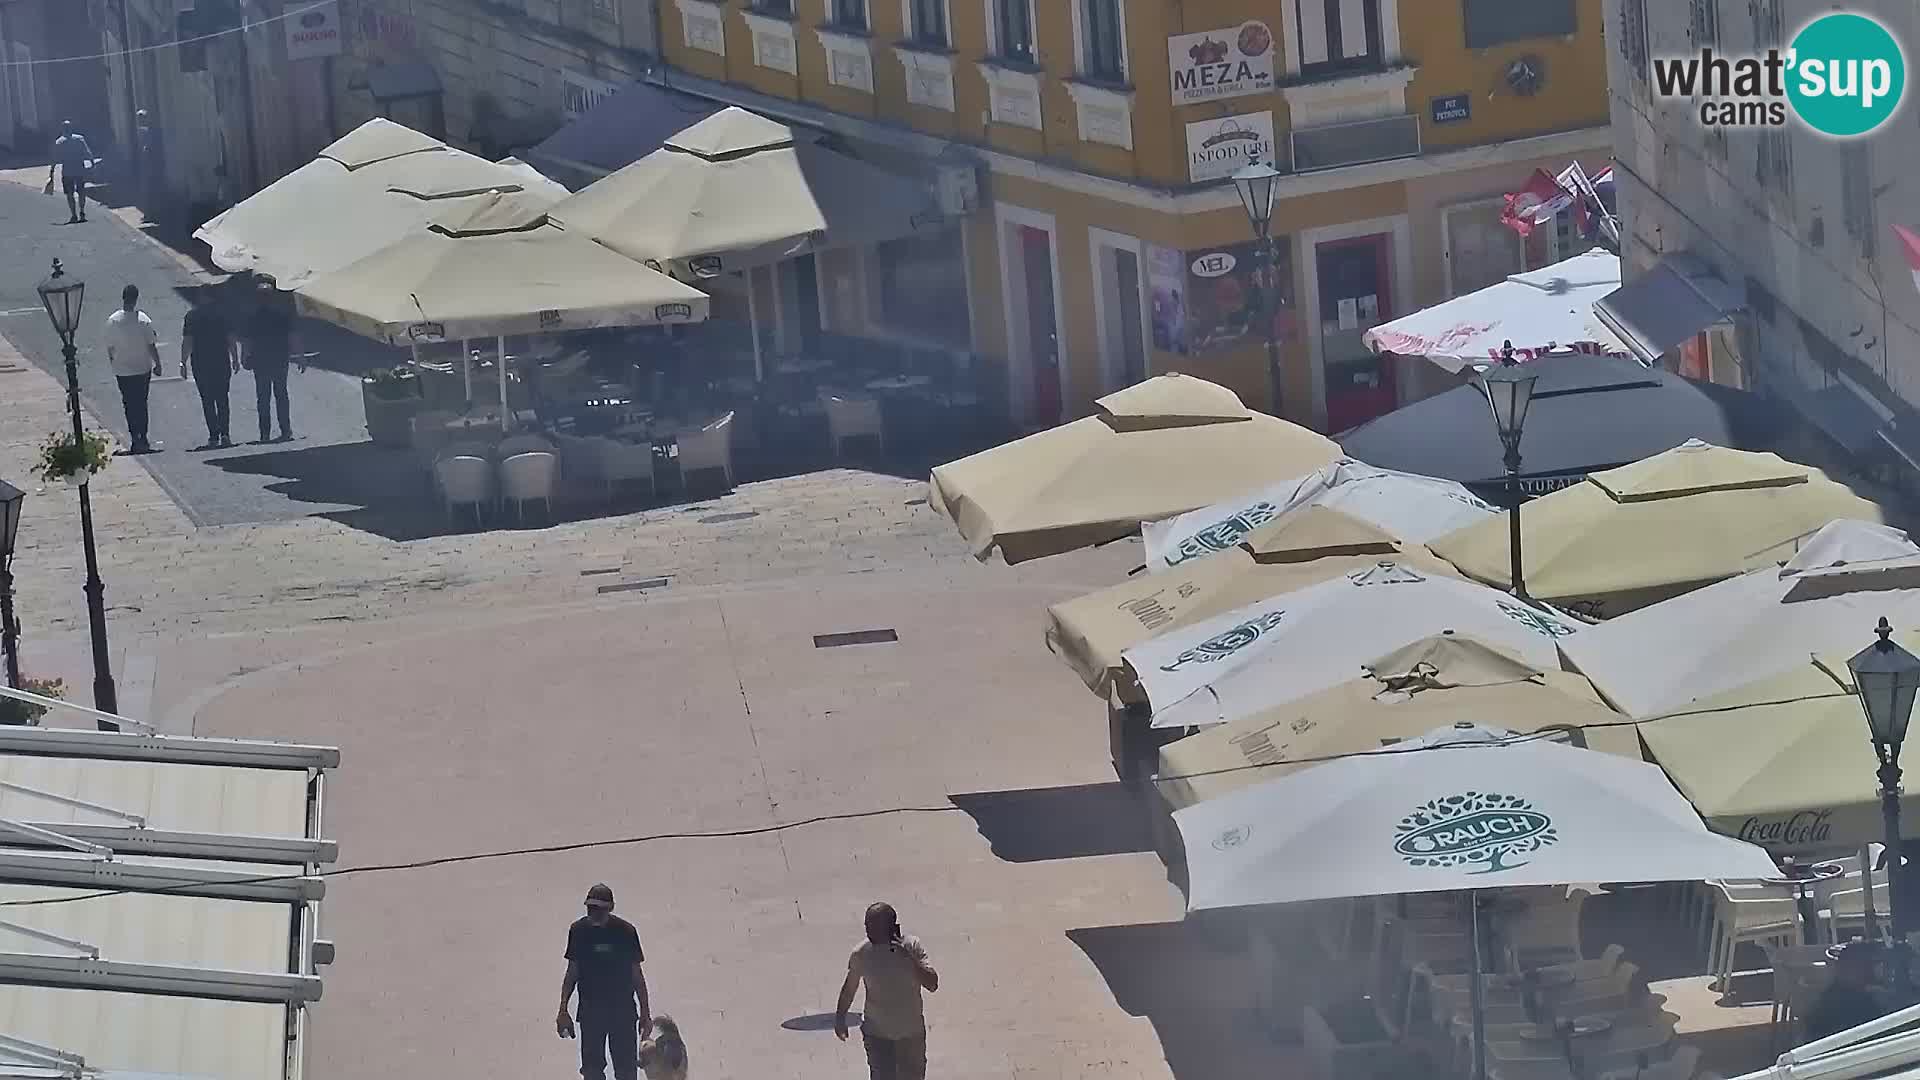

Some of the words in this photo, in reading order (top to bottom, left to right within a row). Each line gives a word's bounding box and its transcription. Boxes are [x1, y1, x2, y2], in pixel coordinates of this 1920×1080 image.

[1174, 61, 1254, 91] MEZA
[1192, 146, 1238, 165] ISPOD
[1433, 815, 1533, 847] RAUCH
